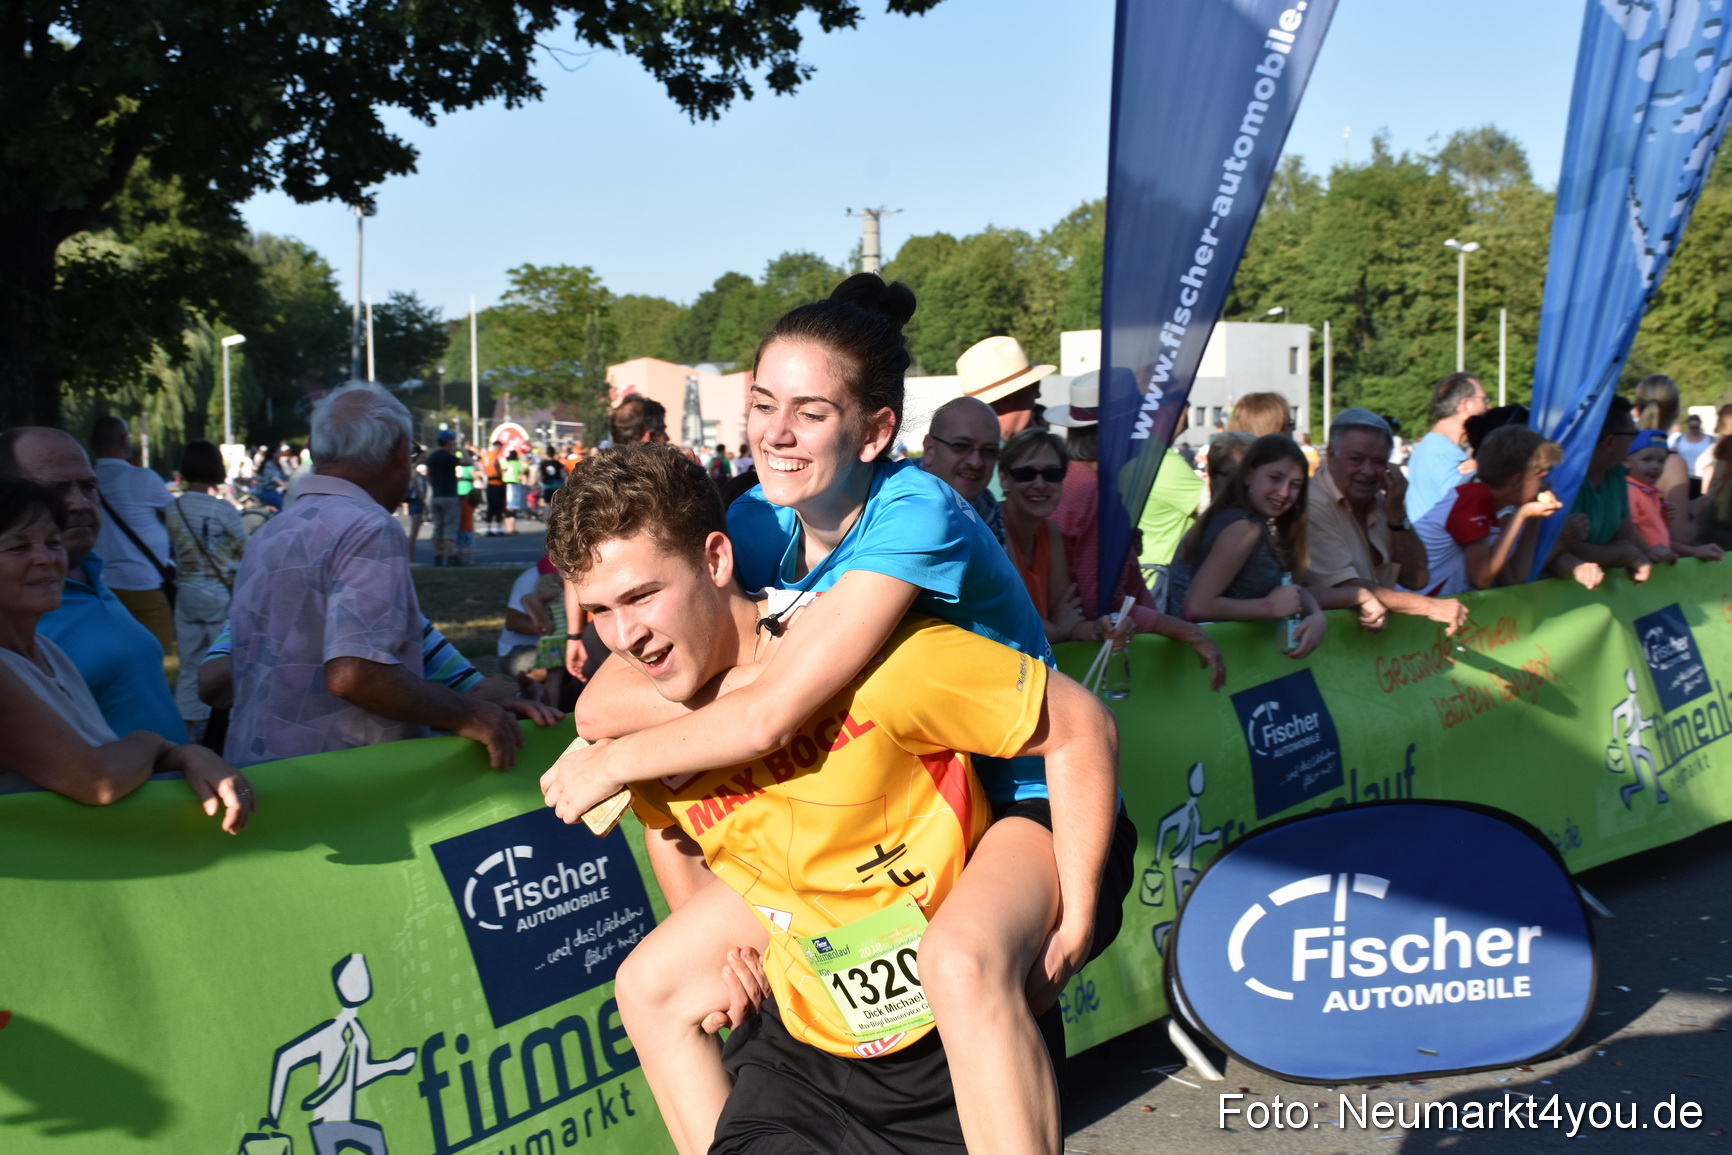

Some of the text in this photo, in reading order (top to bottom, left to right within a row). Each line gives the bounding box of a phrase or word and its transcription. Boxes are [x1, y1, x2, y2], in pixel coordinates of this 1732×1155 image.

[1261, 712, 1320, 748] Fischer
[685, 768, 767, 837] MAX
[493, 855, 609, 918] Fischer
[516, 886, 611, 933] AUTOMOBILE
[1291, 916, 1543, 983] Fischer
[831, 948, 922, 1010] 1320
[1321, 975, 1532, 1014] AUTOMOBILE
[863, 991, 925, 1020] Dick Michael
[884, 1006, 921, 1025] Bauservice
